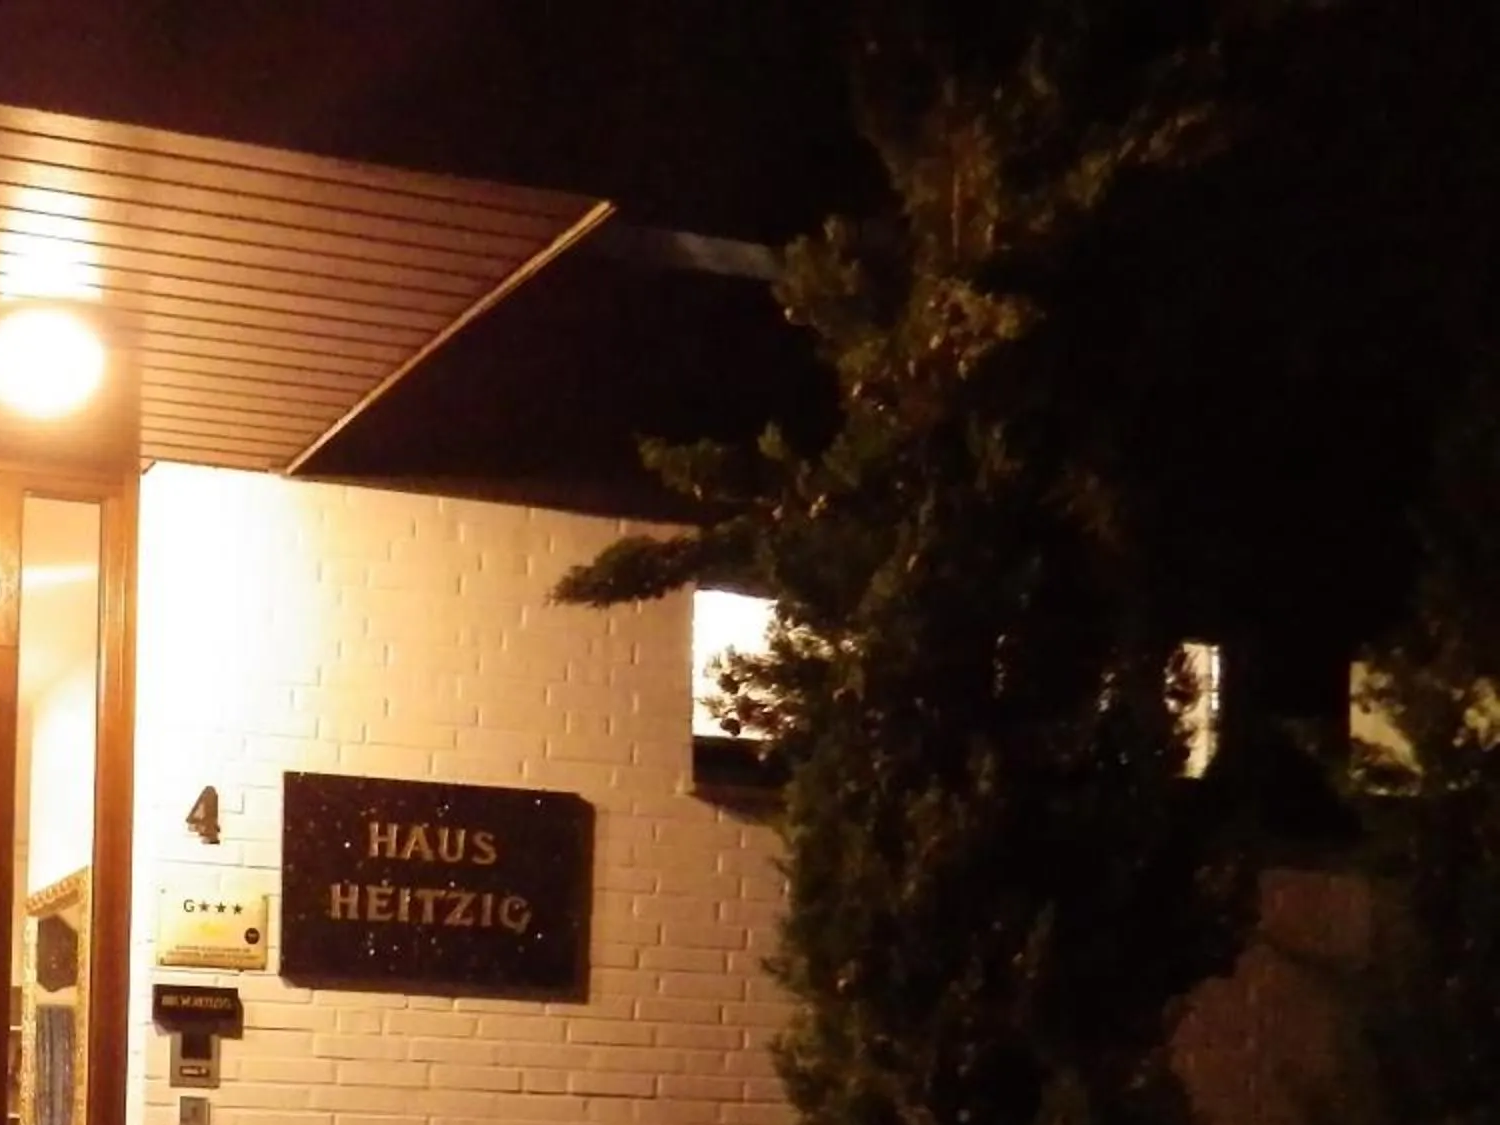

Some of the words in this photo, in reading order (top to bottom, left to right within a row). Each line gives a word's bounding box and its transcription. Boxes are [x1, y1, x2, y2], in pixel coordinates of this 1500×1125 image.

[186, 785, 220, 844] 4
[367, 821, 498, 866] HAUS
[330, 882, 533, 934] HEITZIG
